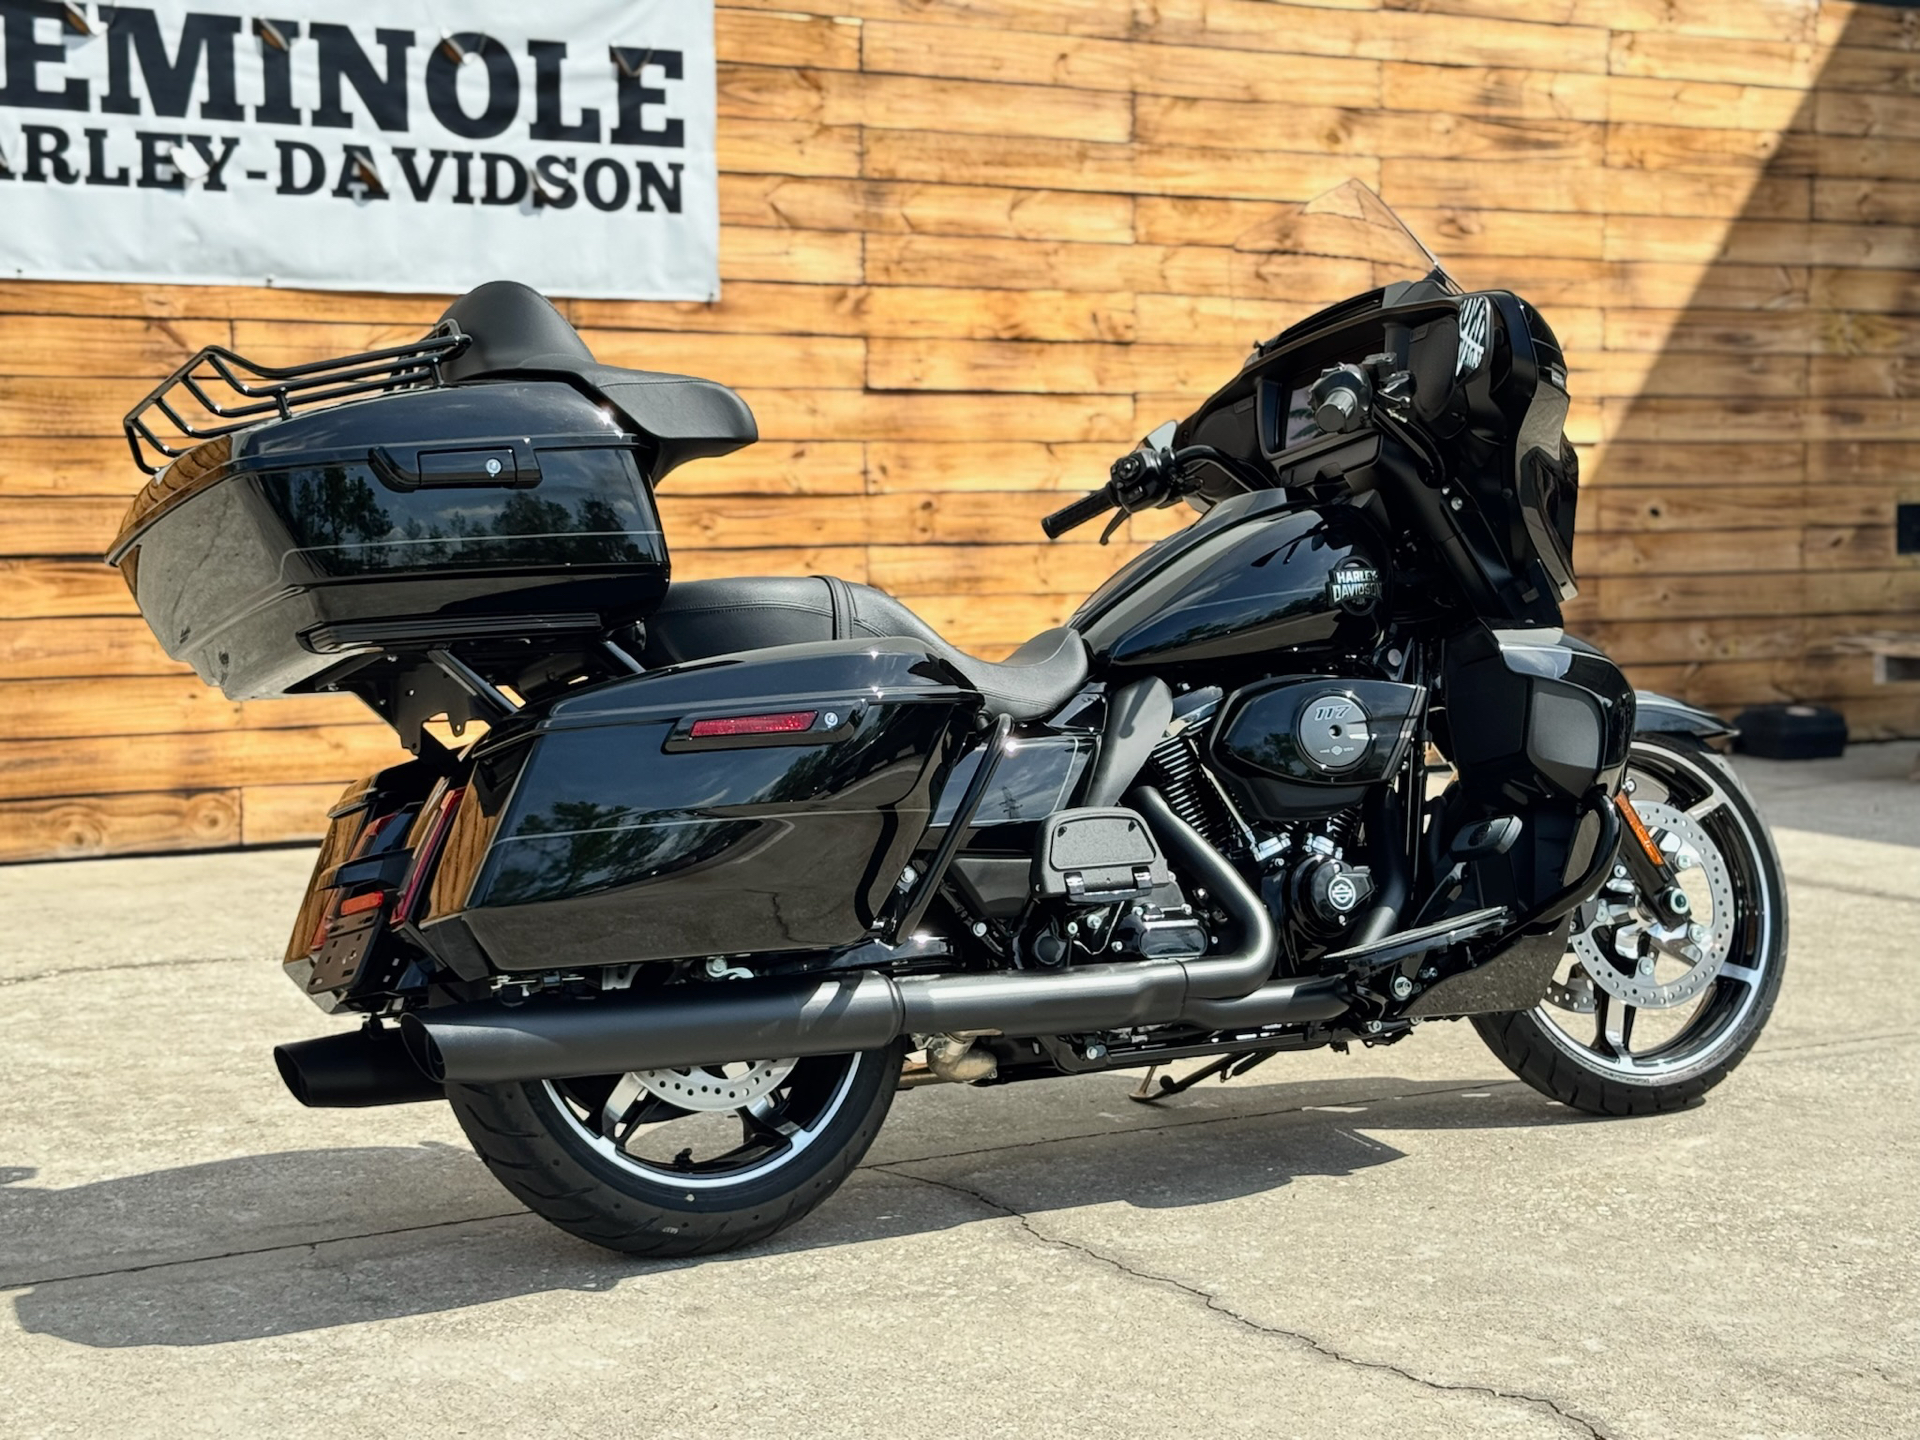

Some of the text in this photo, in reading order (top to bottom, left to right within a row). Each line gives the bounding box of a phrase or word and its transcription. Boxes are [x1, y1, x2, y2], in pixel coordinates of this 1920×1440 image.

[0, 0, 684, 148] EMINOLE
[0, 124, 684, 214] RLEY-DAVIDSON
[1315, 704, 1352, 721] 117
